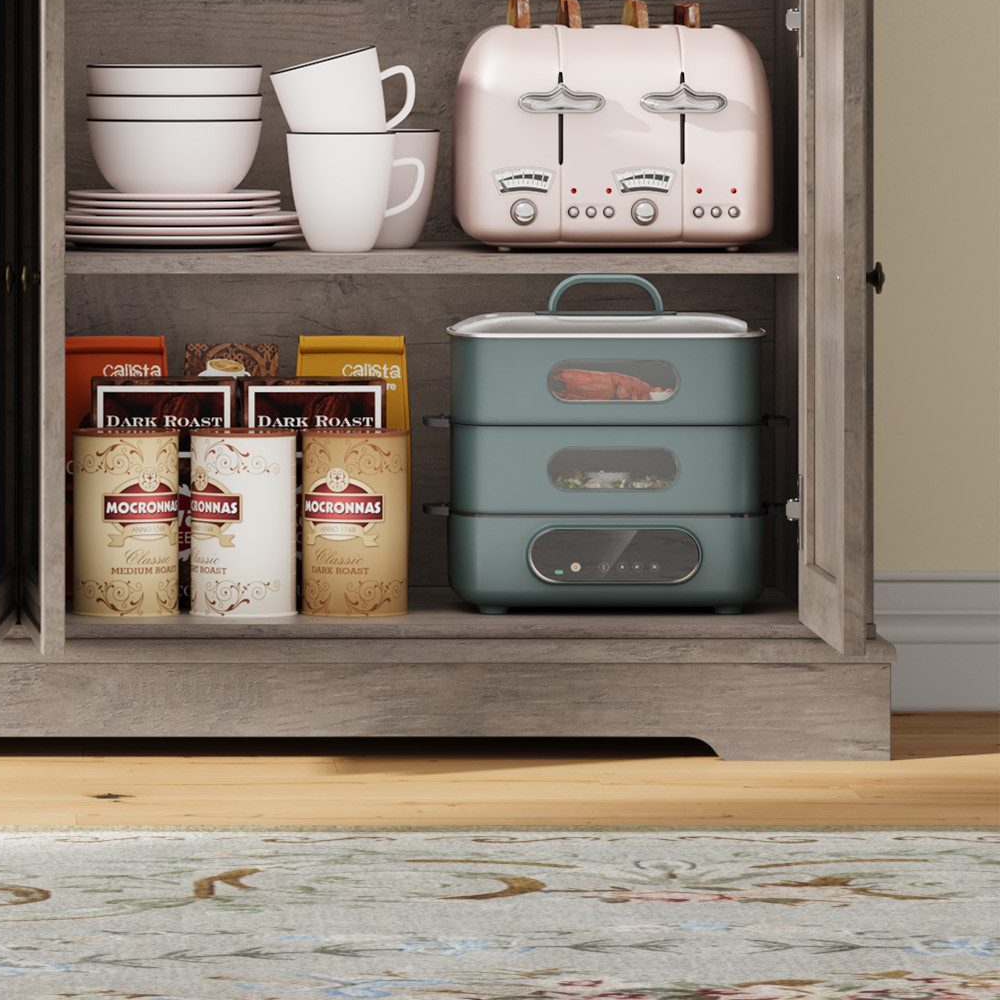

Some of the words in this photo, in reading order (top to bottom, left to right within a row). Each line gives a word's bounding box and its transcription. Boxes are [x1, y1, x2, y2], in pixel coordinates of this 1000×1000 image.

[106, 415, 158, 427] DARK
[163, 415, 223, 427] ROAST
[257, 415, 309, 427] DARK
[315, 415, 374, 427] ROAST
[106, 500, 178, 514] MOCRONNAS
[191, 500, 238, 514] CRONNAS
[305, 500, 381, 514] MOCRONNAS
[124, 550, 170, 565] Classic
[191, 548, 220, 564] lassic
[315, 548, 364, 565] Classic
[111, 566, 153, 575] MEDIUM
[155, 565, 177, 574] ROAST
[200, 566, 227, 574] ROAST
[311, 566, 333, 574] DARK
